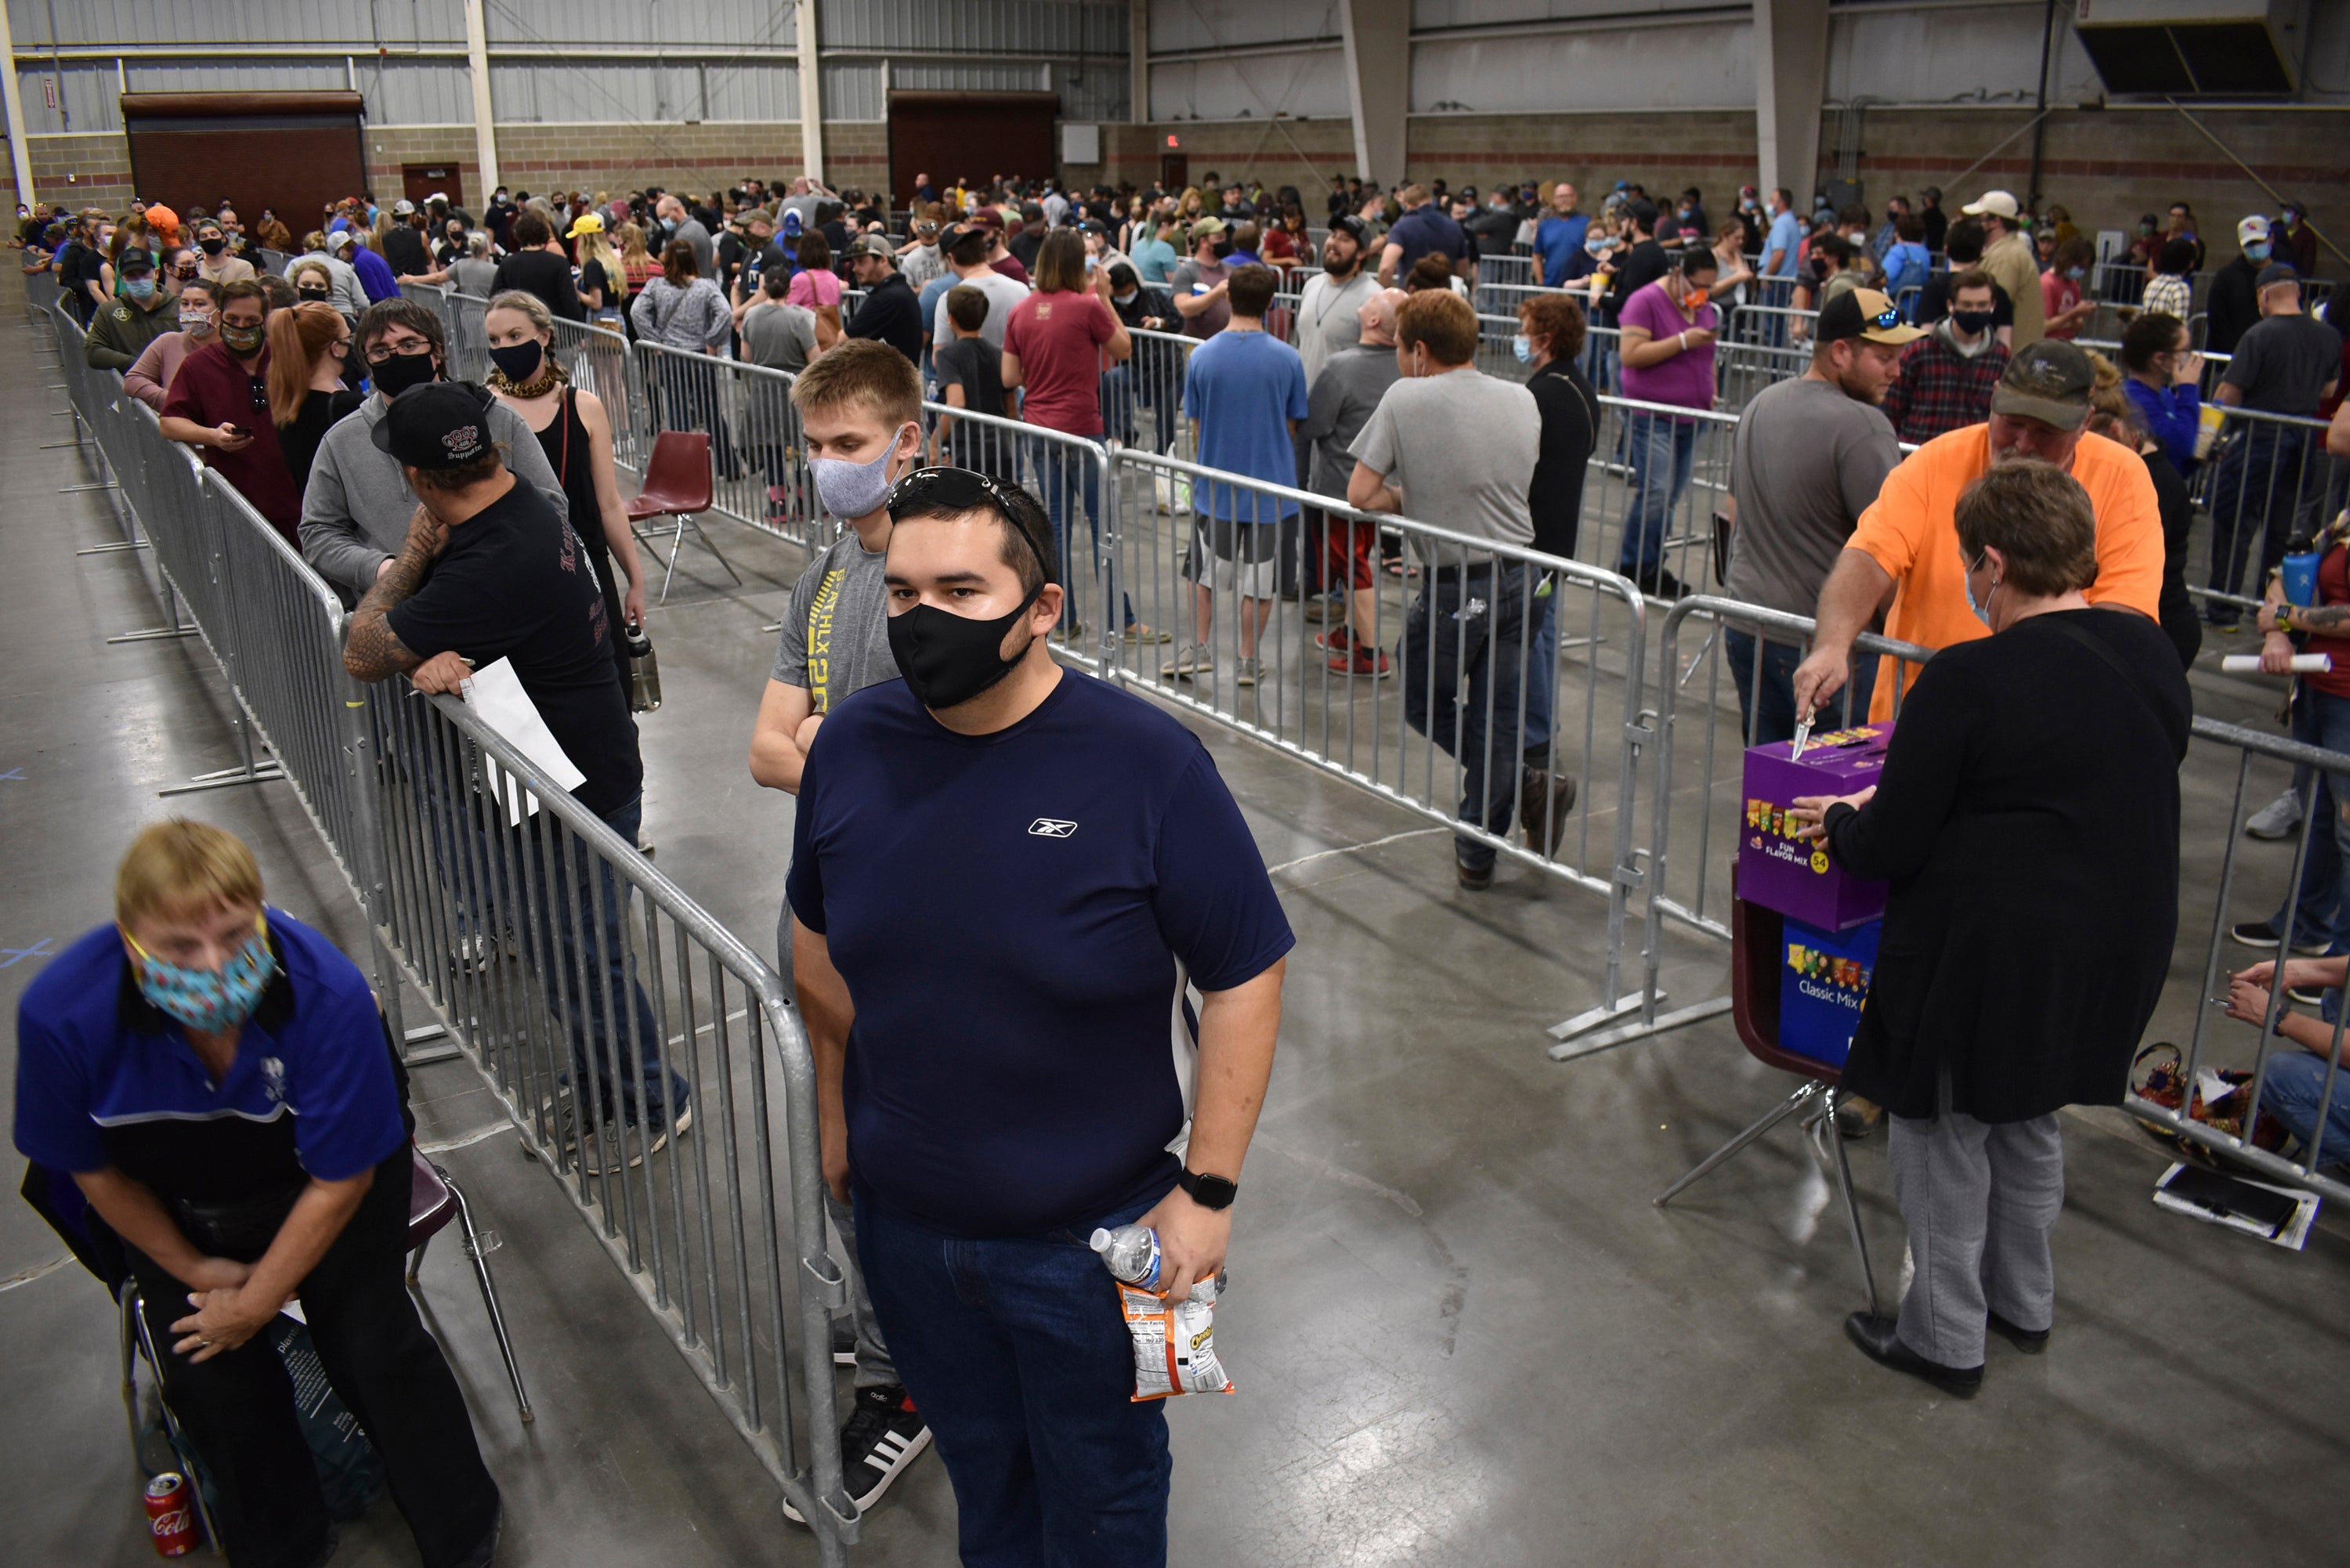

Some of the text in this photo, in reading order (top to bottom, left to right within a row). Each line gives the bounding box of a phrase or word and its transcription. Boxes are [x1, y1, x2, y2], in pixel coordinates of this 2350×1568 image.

[815, 568, 846, 655] G-ATHLX
[1765, 845, 1808, 867] FLAVOR MIX
[1779, 841, 1795, 854] FUN
[1813, 855, 1826, 869] 54
[1799, 979, 1858, 1010] Classic Mix
[277, 1323, 303, 1353] plantin
